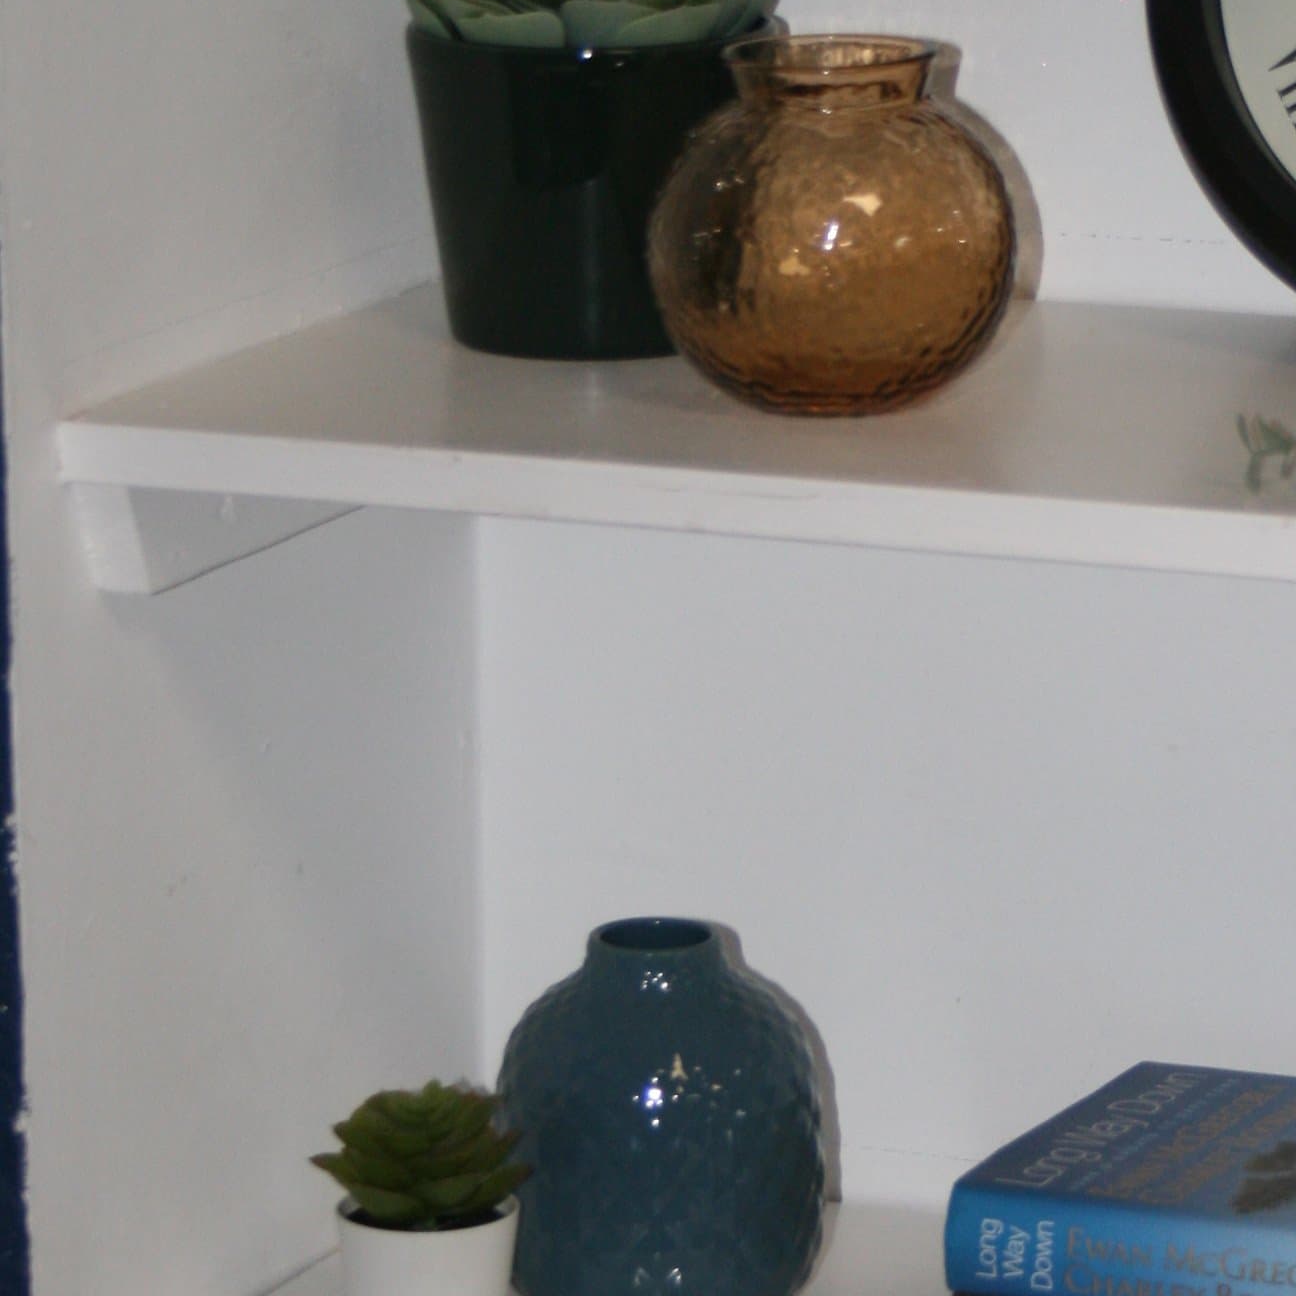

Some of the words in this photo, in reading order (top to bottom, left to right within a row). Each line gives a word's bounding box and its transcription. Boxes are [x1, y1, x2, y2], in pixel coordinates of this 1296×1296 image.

[976, 1217, 1004, 1280] Long
[1003, 1226, 1031, 1279] Way
[1031, 1220, 1055, 1291] Down
[1066, 1229, 1152, 1268] EWAN
